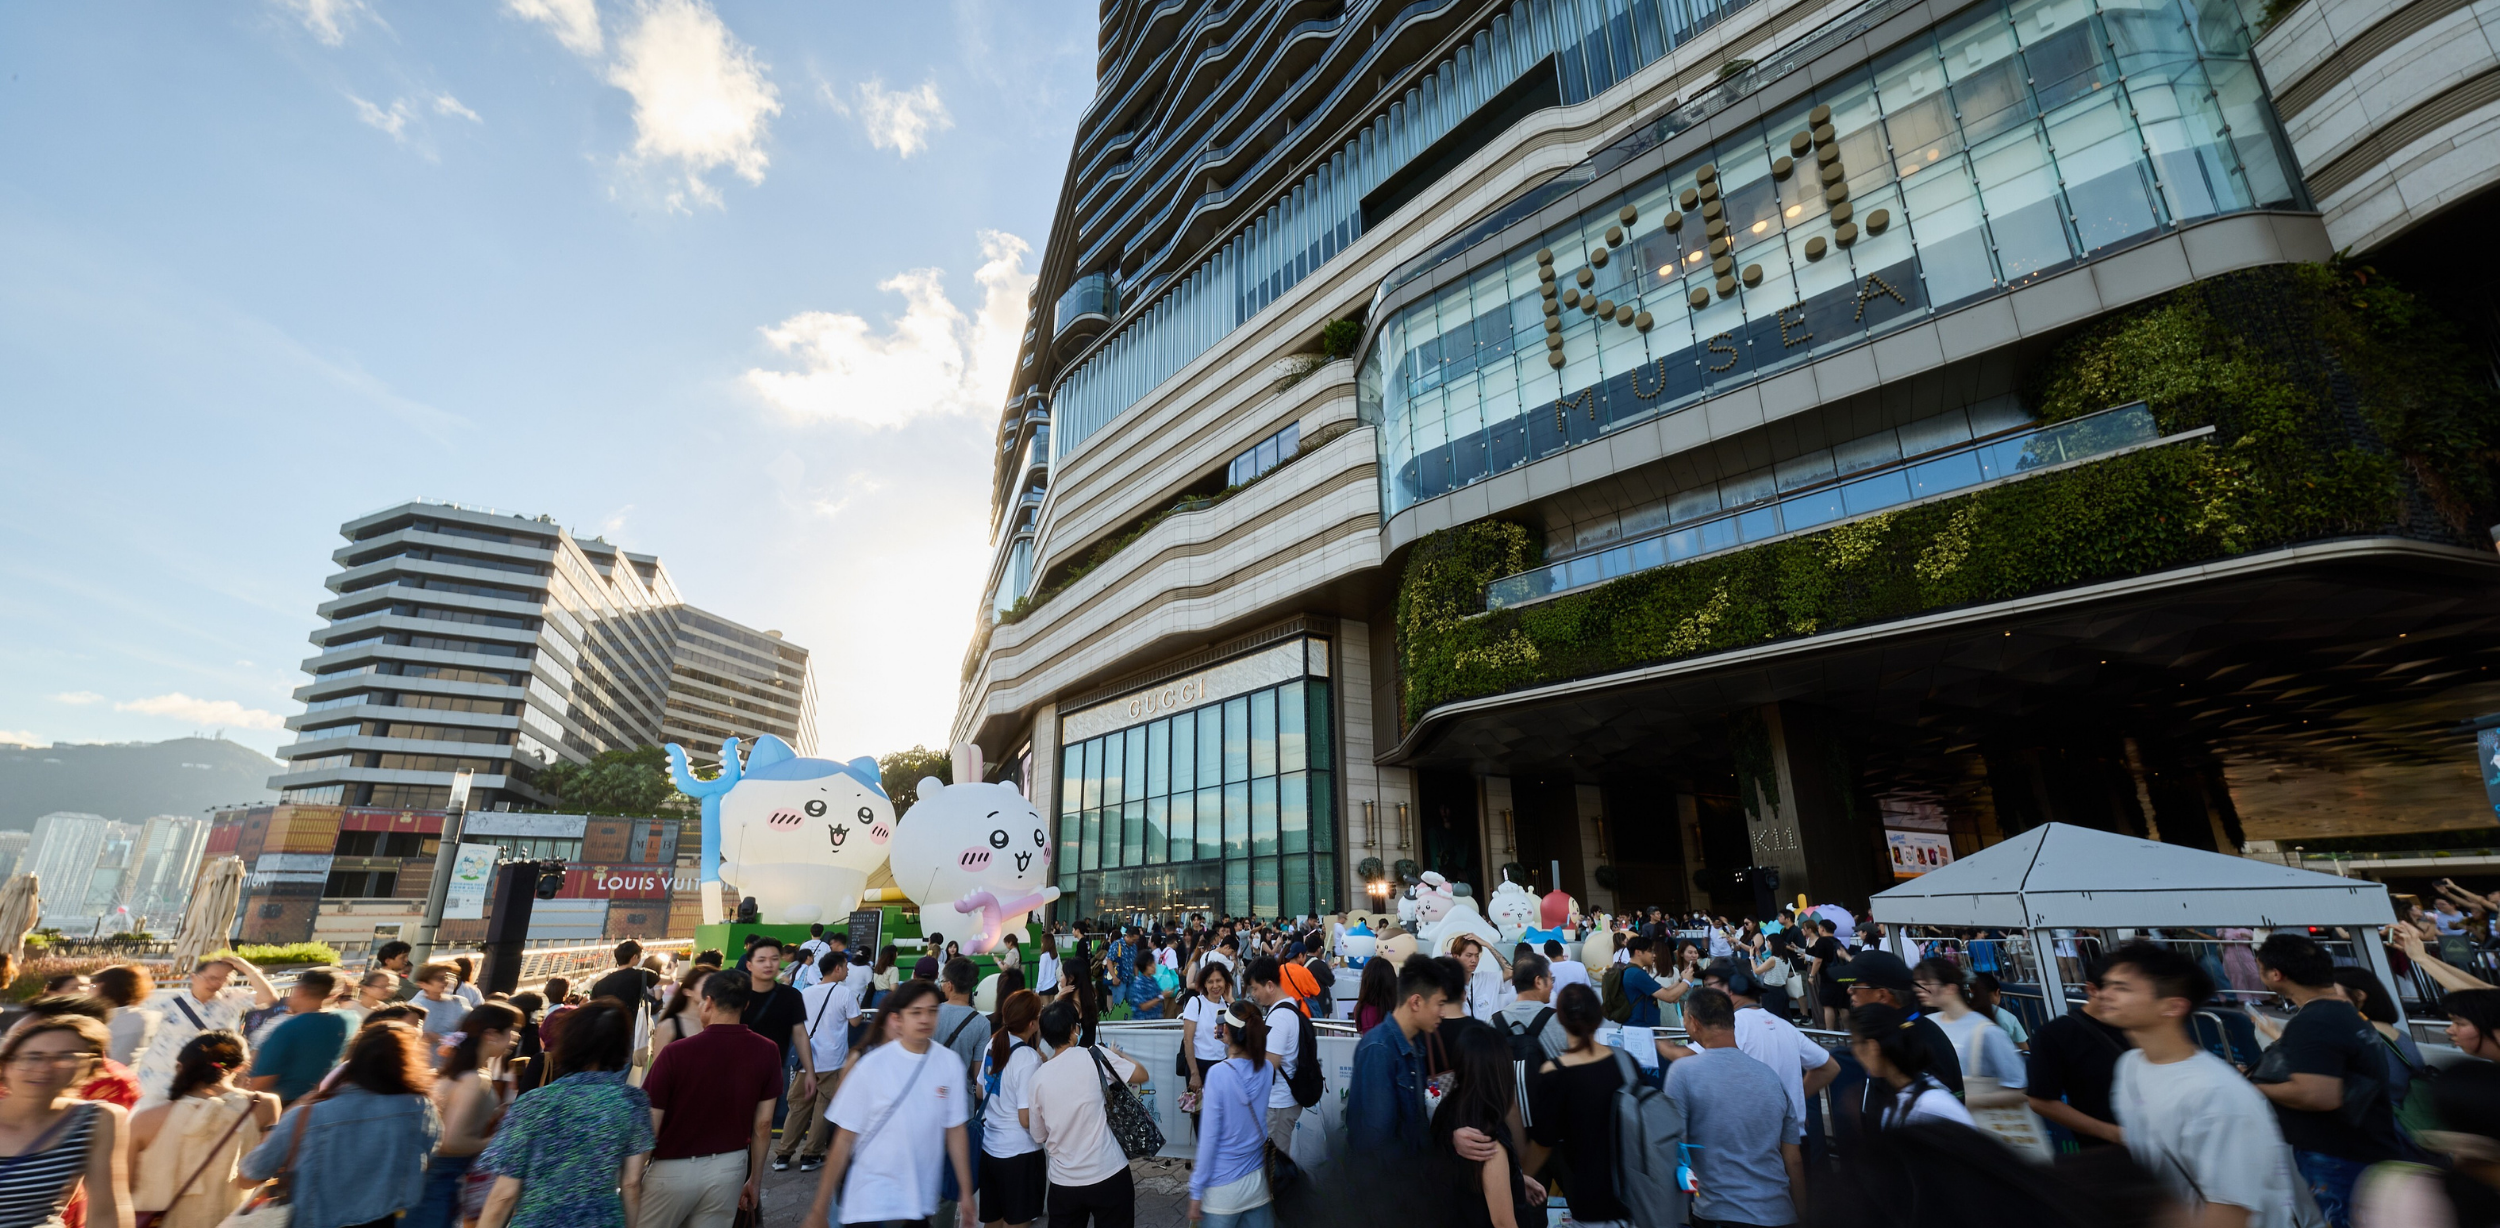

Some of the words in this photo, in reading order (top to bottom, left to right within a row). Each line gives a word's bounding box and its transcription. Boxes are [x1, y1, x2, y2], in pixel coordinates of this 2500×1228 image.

[1537, 104, 1889, 370] K11
[1555, 272, 1906, 432] MUSEA
[1129, 678, 1205, 718] GUCCI
[1752, 827, 1797, 852] K11
[598, 877, 655, 891] LOUIS
